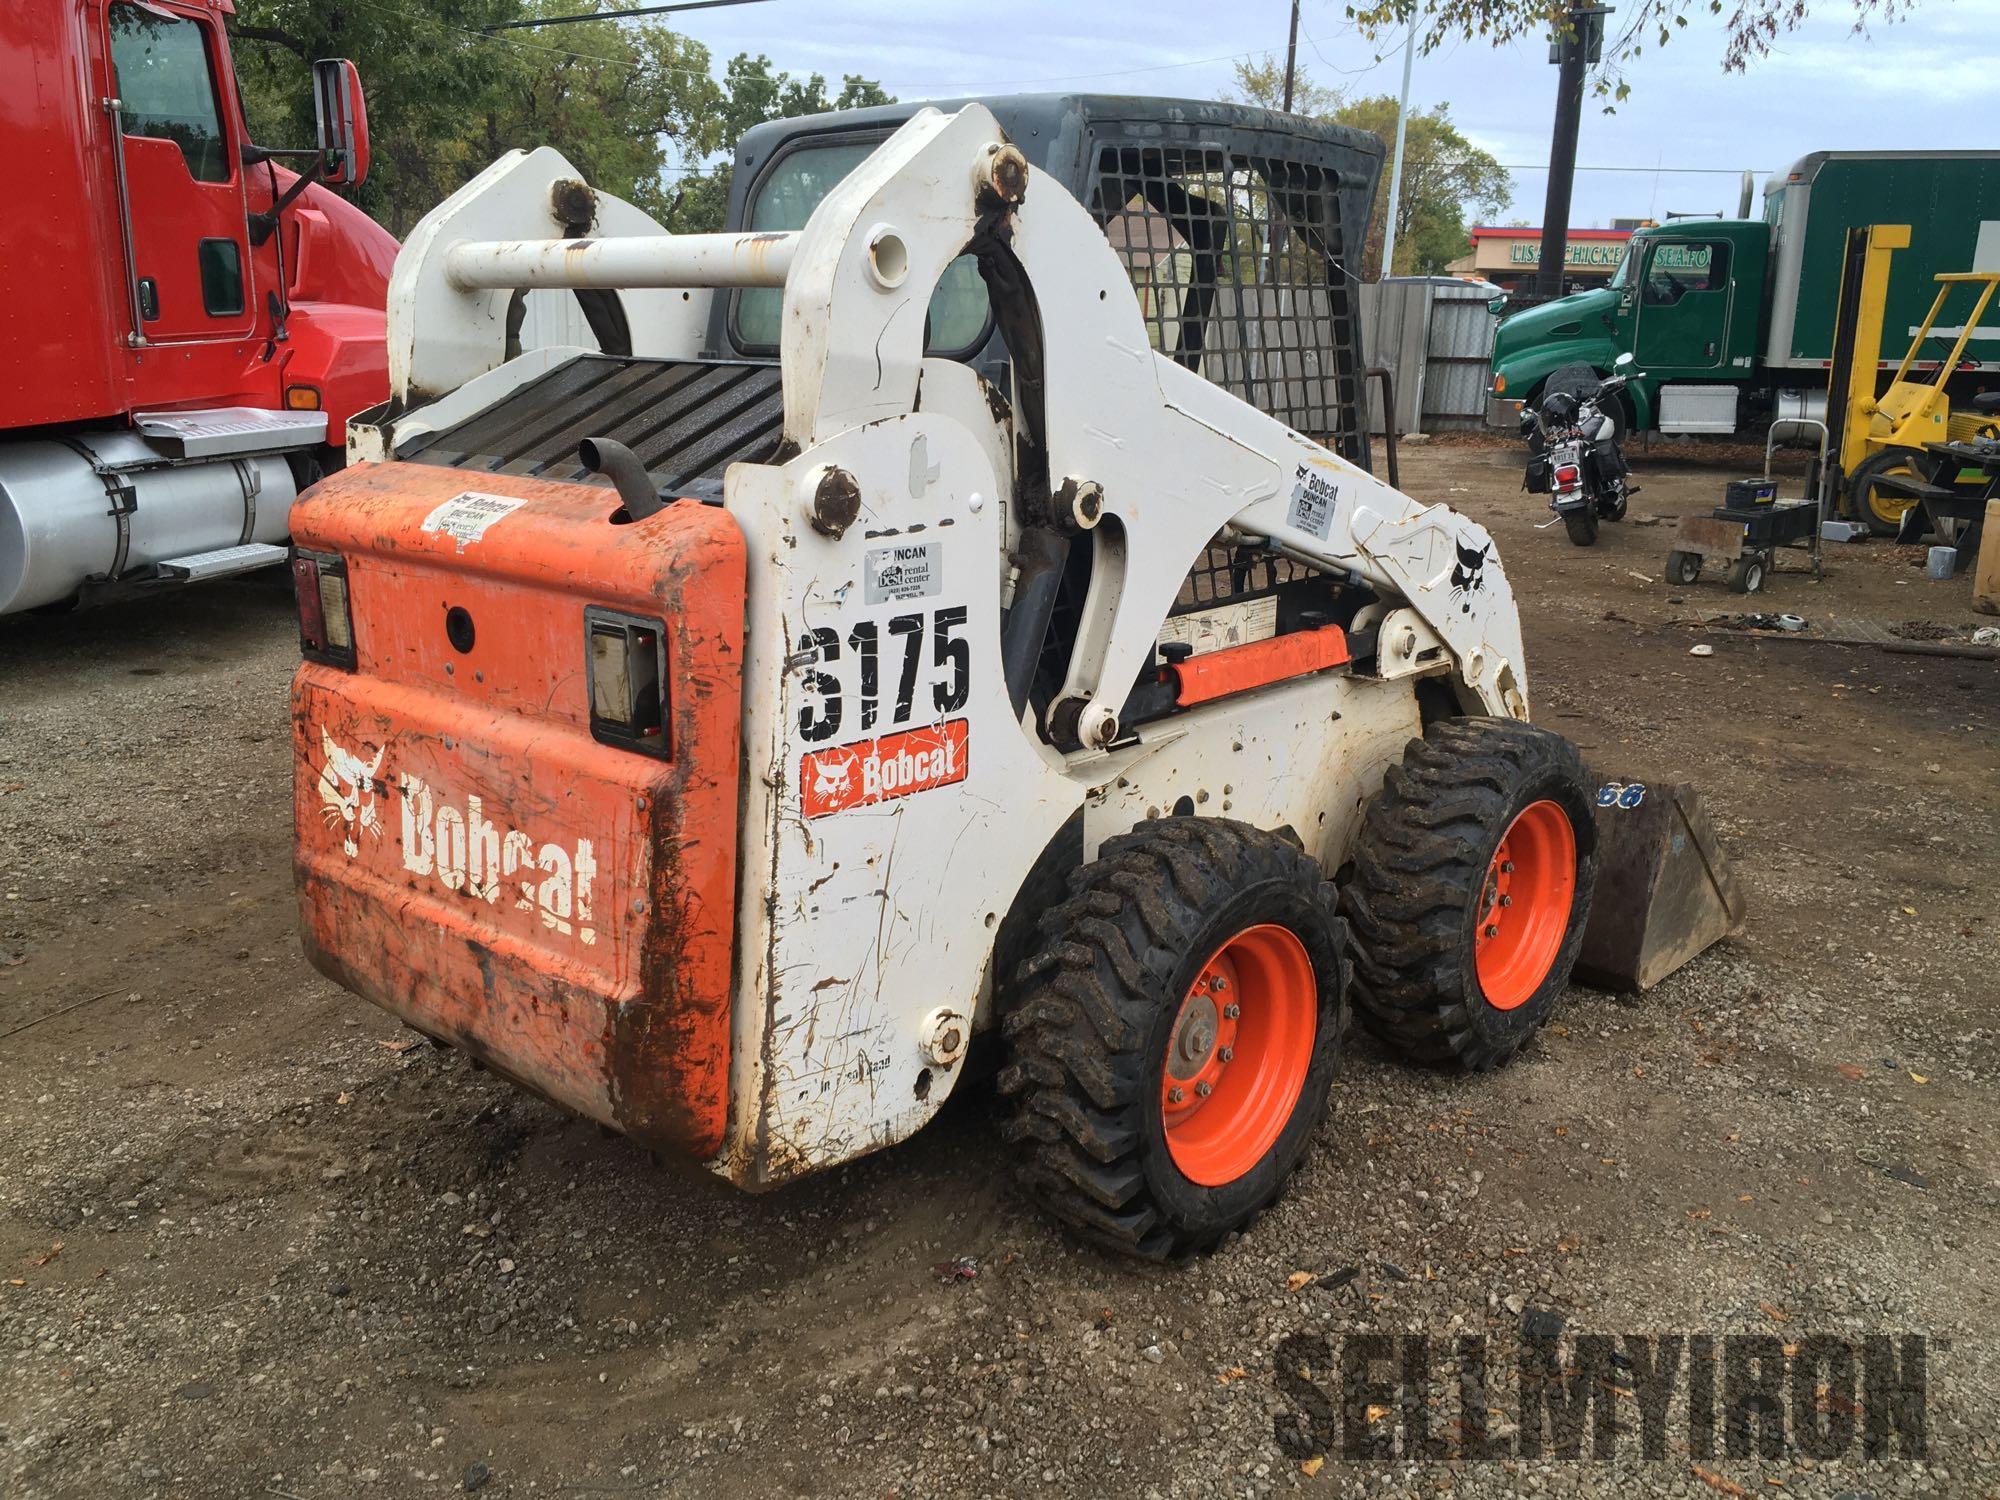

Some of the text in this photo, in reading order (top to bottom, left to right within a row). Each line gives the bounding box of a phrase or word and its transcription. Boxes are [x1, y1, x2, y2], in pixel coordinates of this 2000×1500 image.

[1563, 243, 1624, 265] CHICKE
[1655, 246, 1709, 267] SEAFO
[1303, 490, 1328, 508] DUNCAN
[1309, 473, 1339, 502] Bobcat
[904, 562, 929, 575] rental
[904, 574, 931, 584] center
[797, 605, 970, 742] S175
[863, 739, 956, 797] Bobcat
[400, 771, 597, 945] Bobcat
